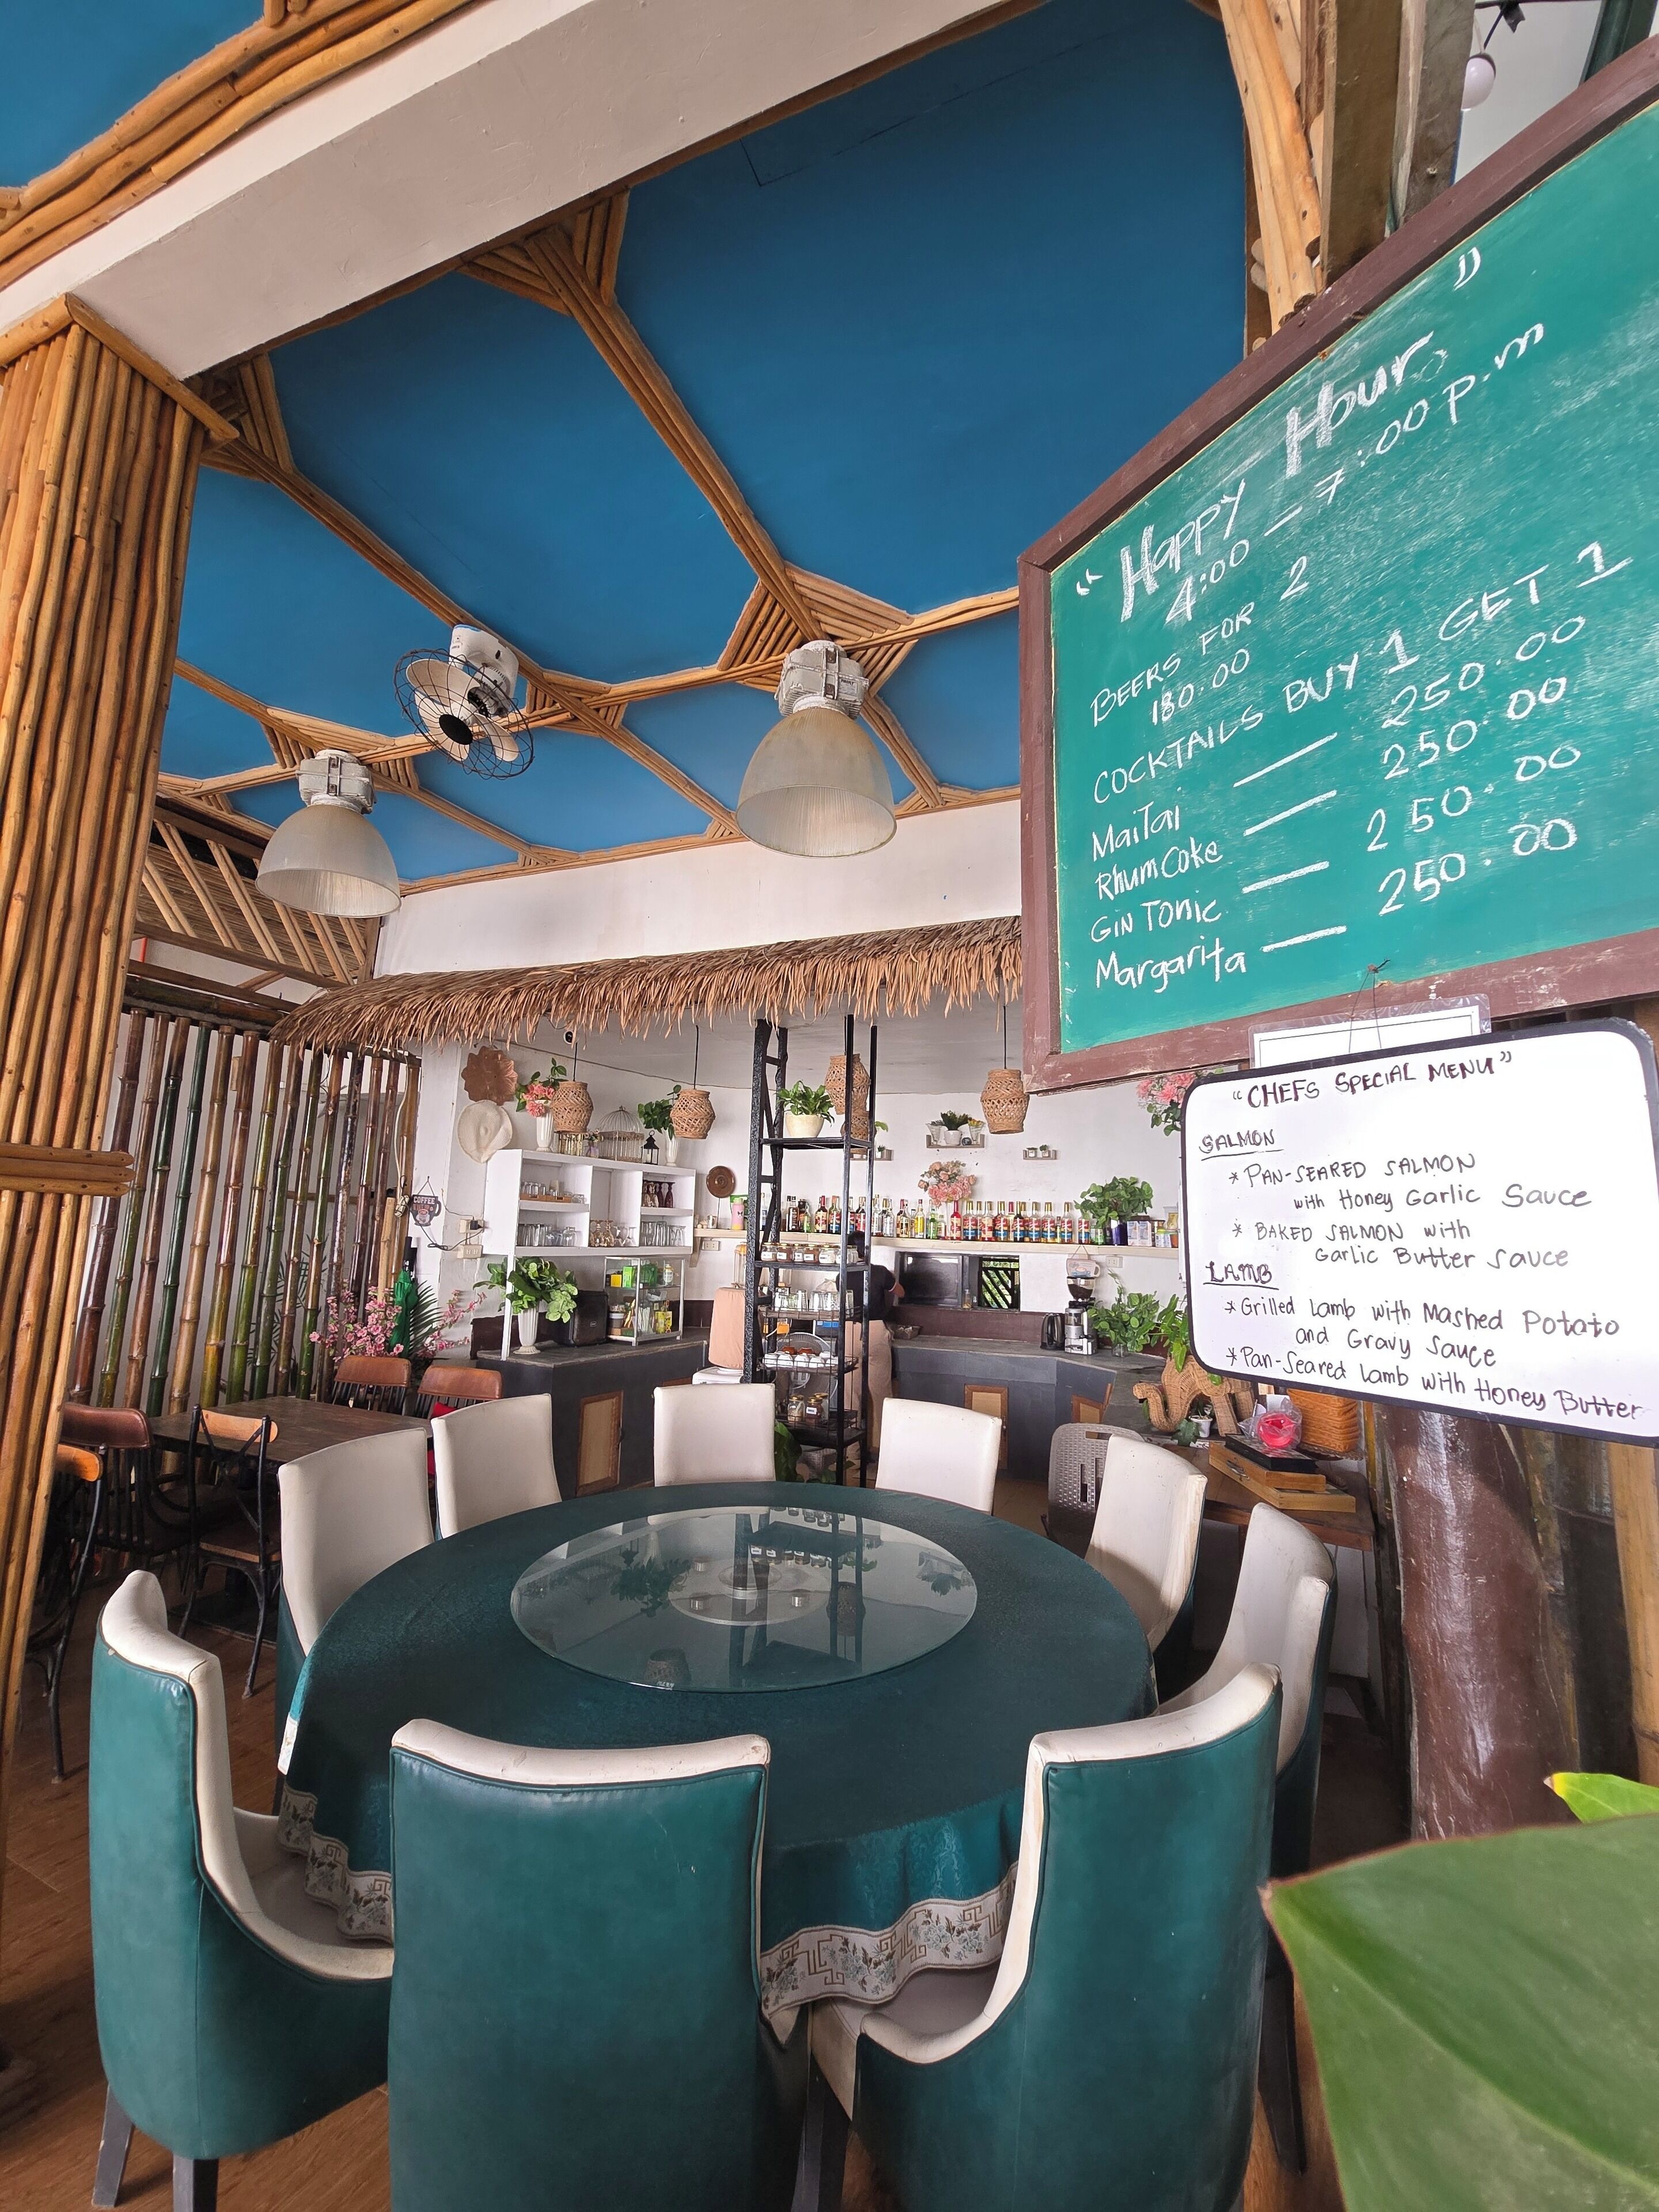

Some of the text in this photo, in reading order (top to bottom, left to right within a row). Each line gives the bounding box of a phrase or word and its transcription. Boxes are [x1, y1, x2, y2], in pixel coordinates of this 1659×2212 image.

[1165, 539, 1249, 623] 4:00
[1314, 399, 1430, 506] 7:00
[1090, 556, 1309, 727] BEERS FOR 2
[1094, 541, 1634, 804] COCKTAILS BUY 1 GET 1
[1152, 649, 1250, 726] 180.00
[1096, 935, 1247, 994] Margarita
[1335, 1062, 1417, 1095] SPECIAL
[1199, 1128, 1275, 1154] SALMON
[1243, 1153, 1475, 1188] PAN-SEARED SALMON
[413, 1196, 436, 1205] COFFEE
[1293, 1183, 1592, 1213] with Honey Garlic Sauce
[1254, 1219, 1471, 1242] BAKED SALMON with
[1205, 1260, 1273, 1285] LAMB
[1315, 1244, 1378, 1264] Garlic
[1393, 1247, 1476, 1270] Butter
[1240, 1296, 1296, 1316] Grilled
[1371, 1300, 1412, 1325] with
[1423, 1302, 1503, 1331] Mashed
[1522, 1309, 1620, 1338] Potato
[1296, 1326, 1497, 1368] and Gravy Sauce
[1240, 1346, 1347, 1380] Pan-Seared
[1421, 1371, 1466, 1394] with
[1474, 1377, 1547, 1411] Honey
[1552, 1389, 1644, 1420] Butter
